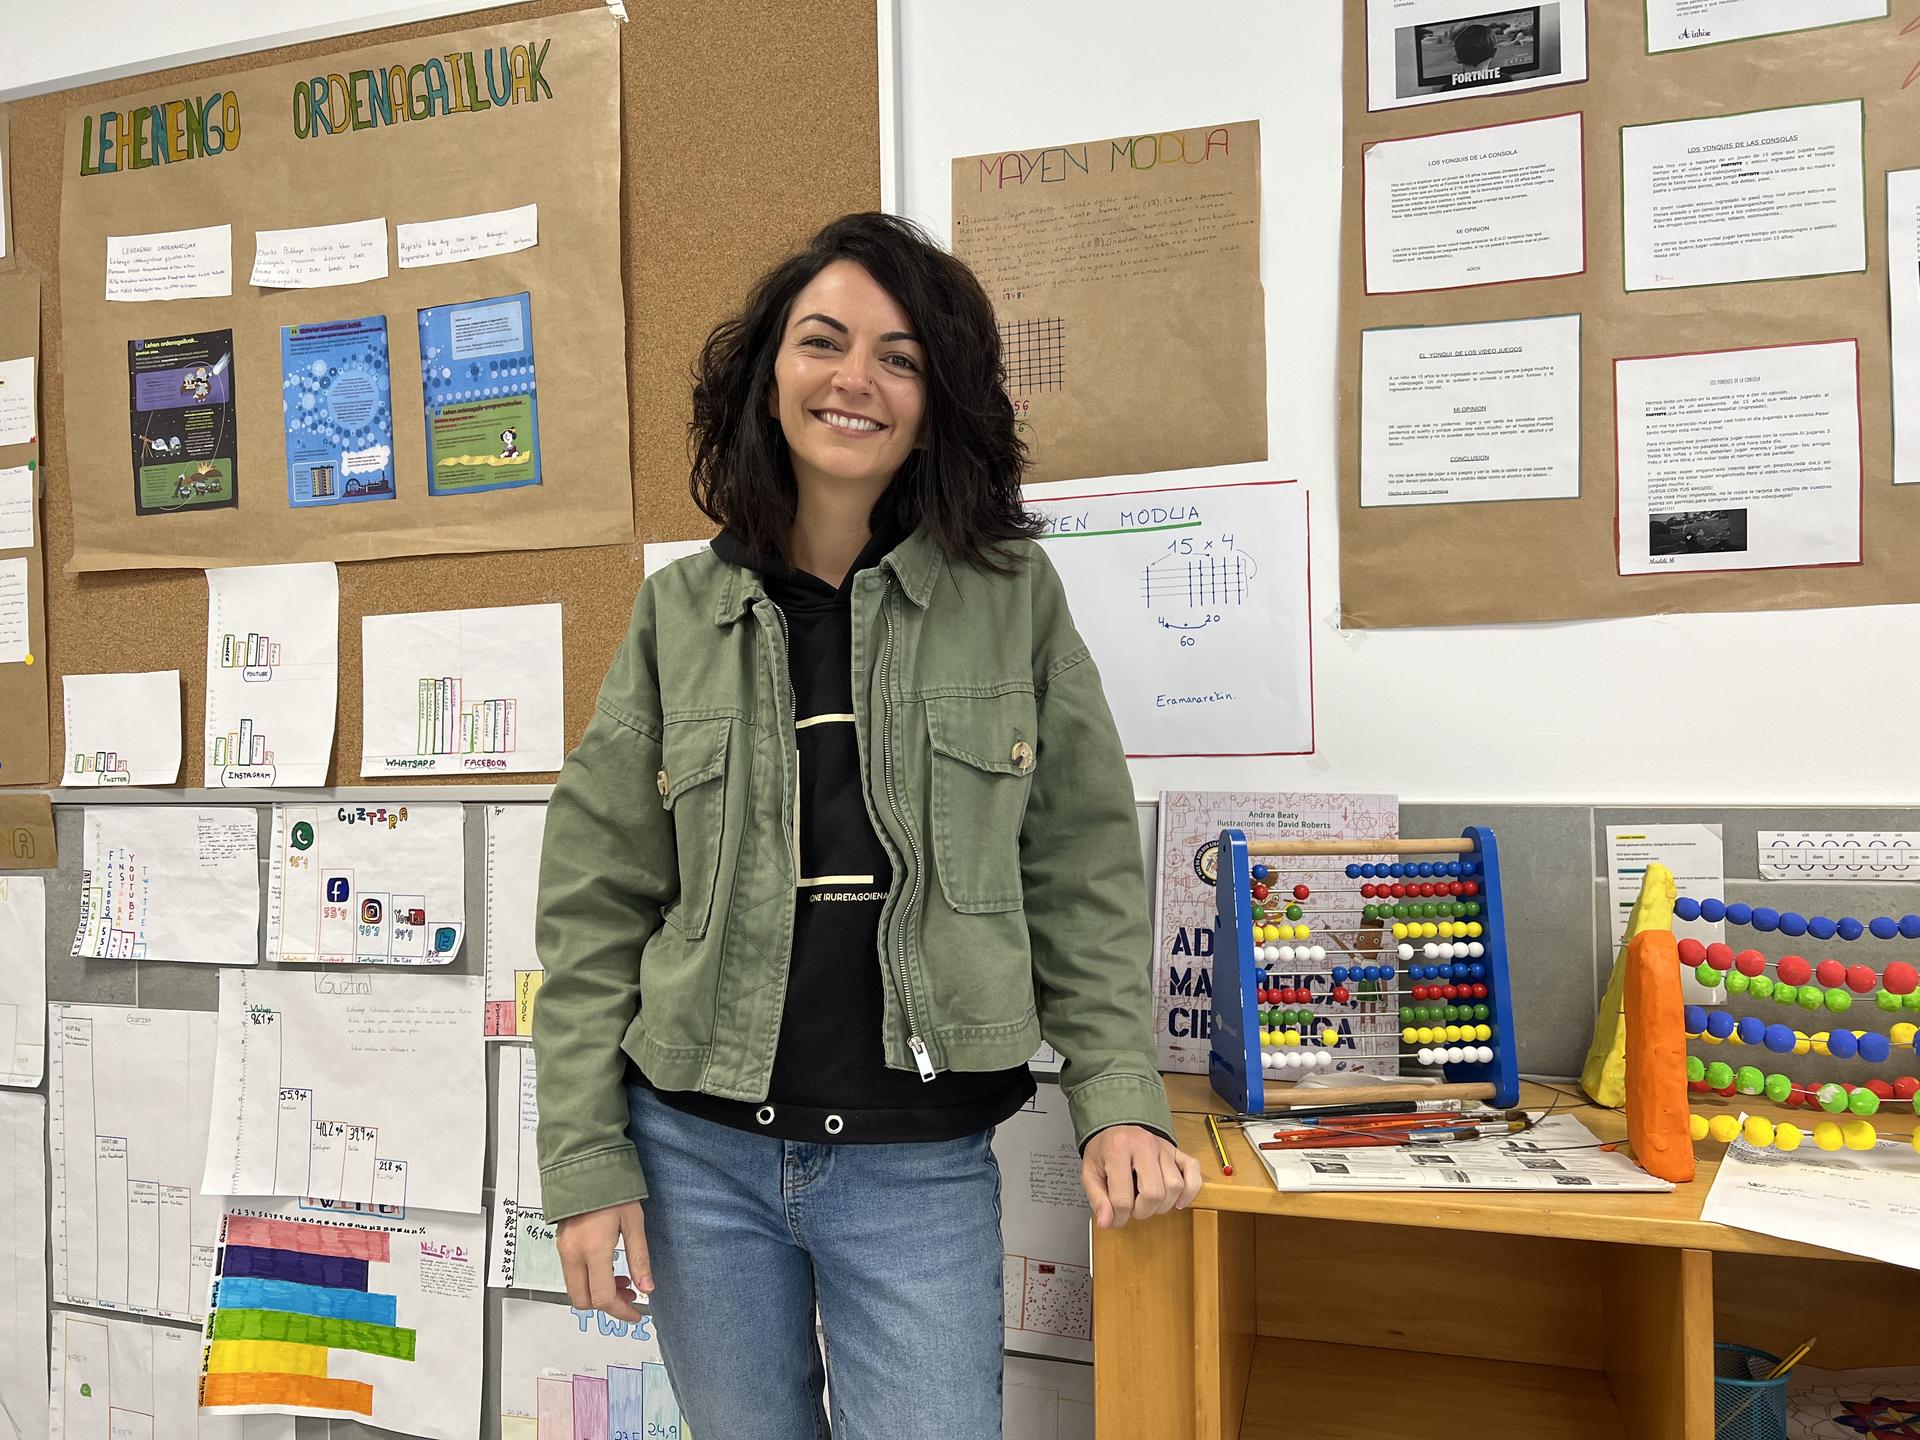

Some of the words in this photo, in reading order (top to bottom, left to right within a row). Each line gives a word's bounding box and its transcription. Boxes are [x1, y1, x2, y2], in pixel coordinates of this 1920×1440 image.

[1452, 66, 1501, 86] FORTNITE
[80, 91, 241, 176] LEHENENGO
[292, 38, 553, 140] ORDENAGAILUAK
[1702, 142, 1733, 151] YONQUIS
[1760, 134, 1798, 145] CONSOLAS
[979, 145, 1088, 193] MAYEN
[1110, 128, 1229, 173] MODUA
[1441, 156, 1468, 164] YONQUIS
[1487, 149, 1517, 158] CONSOLA
[1121, 506, 1201, 528] MODUA
[1167, 537, 1193, 555] 15
[1222, 533, 1235, 551] 4
[1205, 614, 1221, 624] 20
[1180, 635, 1195, 647] 60
[385, 758, 435, 768] WHATSAPP
[464, 759, 507, 768] FACEBOOK
[228, 771, 272, 781] INSTAGRAM
[337, 807, 408, 829] GUZTIRA
[1248, 811, 1275, 819] Andrea
[1277, 811, 1298, 820] Beaty
[1217, 819, 1264, 827] Ilustraciones
[1266, 820, 1275, 828] de
[1277, 820, 1298, 828] David
[1301, 821, 1331, 829] Roberts
[503, 1198, 515, 1206] 100
[502, 1264, 511, 1273] 20
